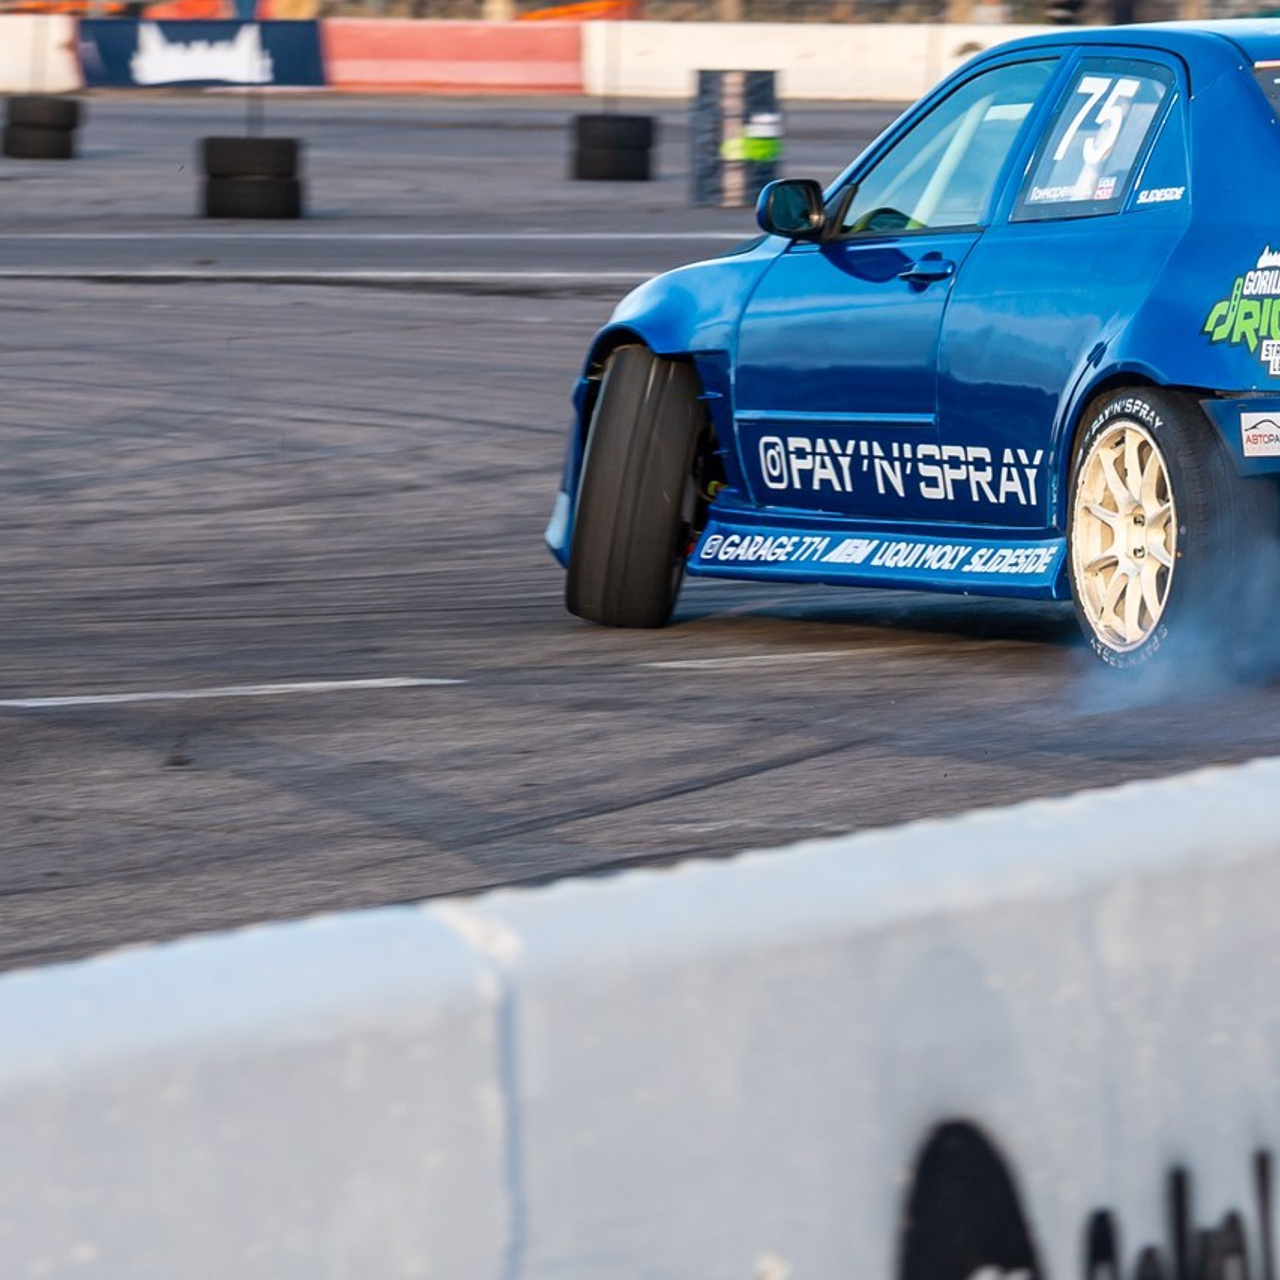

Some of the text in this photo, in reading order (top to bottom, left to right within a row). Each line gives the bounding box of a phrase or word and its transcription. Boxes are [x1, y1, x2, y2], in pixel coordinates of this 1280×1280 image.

[1054, 76, 1140, 163] 75
[870, 540, 926, 569] LIQUI
[919, 543, 972, 570] MOLY
[961, 546, 1058, 574] SLIDESIDE
